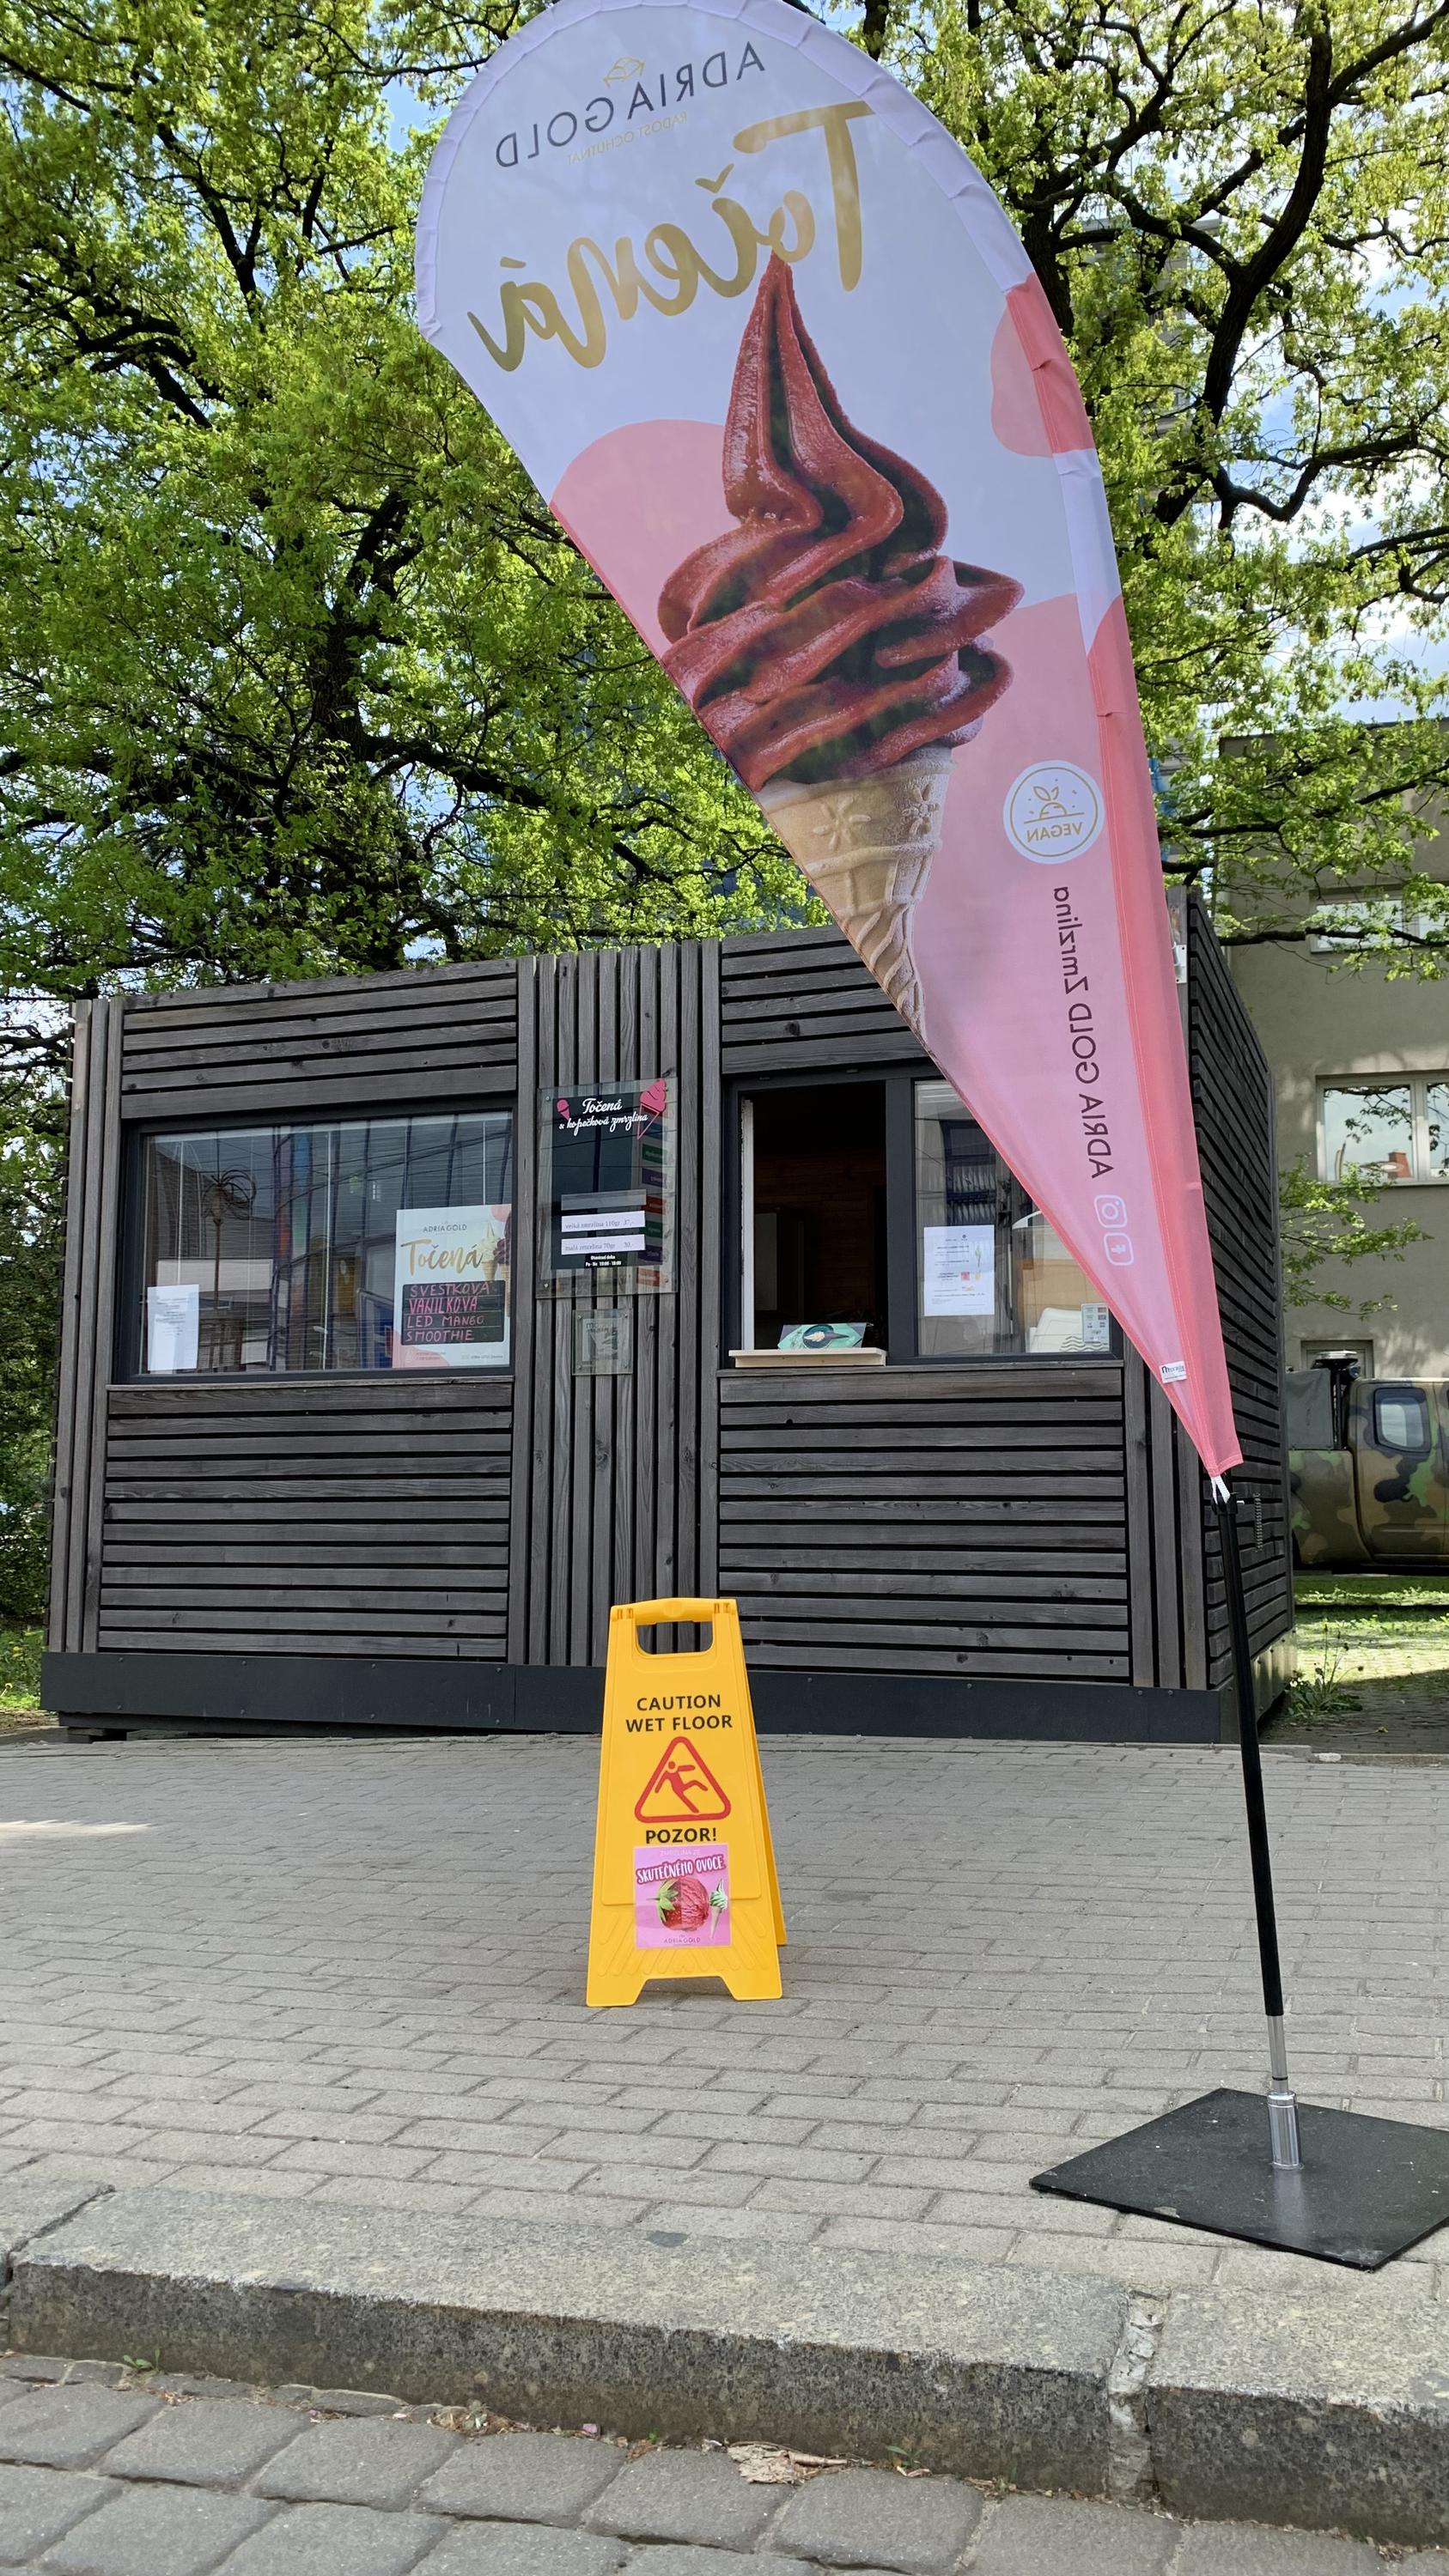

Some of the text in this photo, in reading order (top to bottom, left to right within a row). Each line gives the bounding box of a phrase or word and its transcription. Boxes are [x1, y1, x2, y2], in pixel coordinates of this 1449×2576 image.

[582, 1097, 623, 1115] Točená
[566, 1115, 610, 1136] kopečková
[610, 1111, 649, 1133] zmrzlina
[400, 1238, 484, 1276] Točená
[406, 1315, 434, 1328] LED
[405, 1329, 474, 1343] SMOOTHIE
[636, 1694, 721, 1711] CAUTION
[625, 1715, 733, 1733] WET FLOOR
[645, 1827, 716, 1844] POZOR!
[636, 1855, 723, 1884] SKUTEČNÉHO OVOCE
